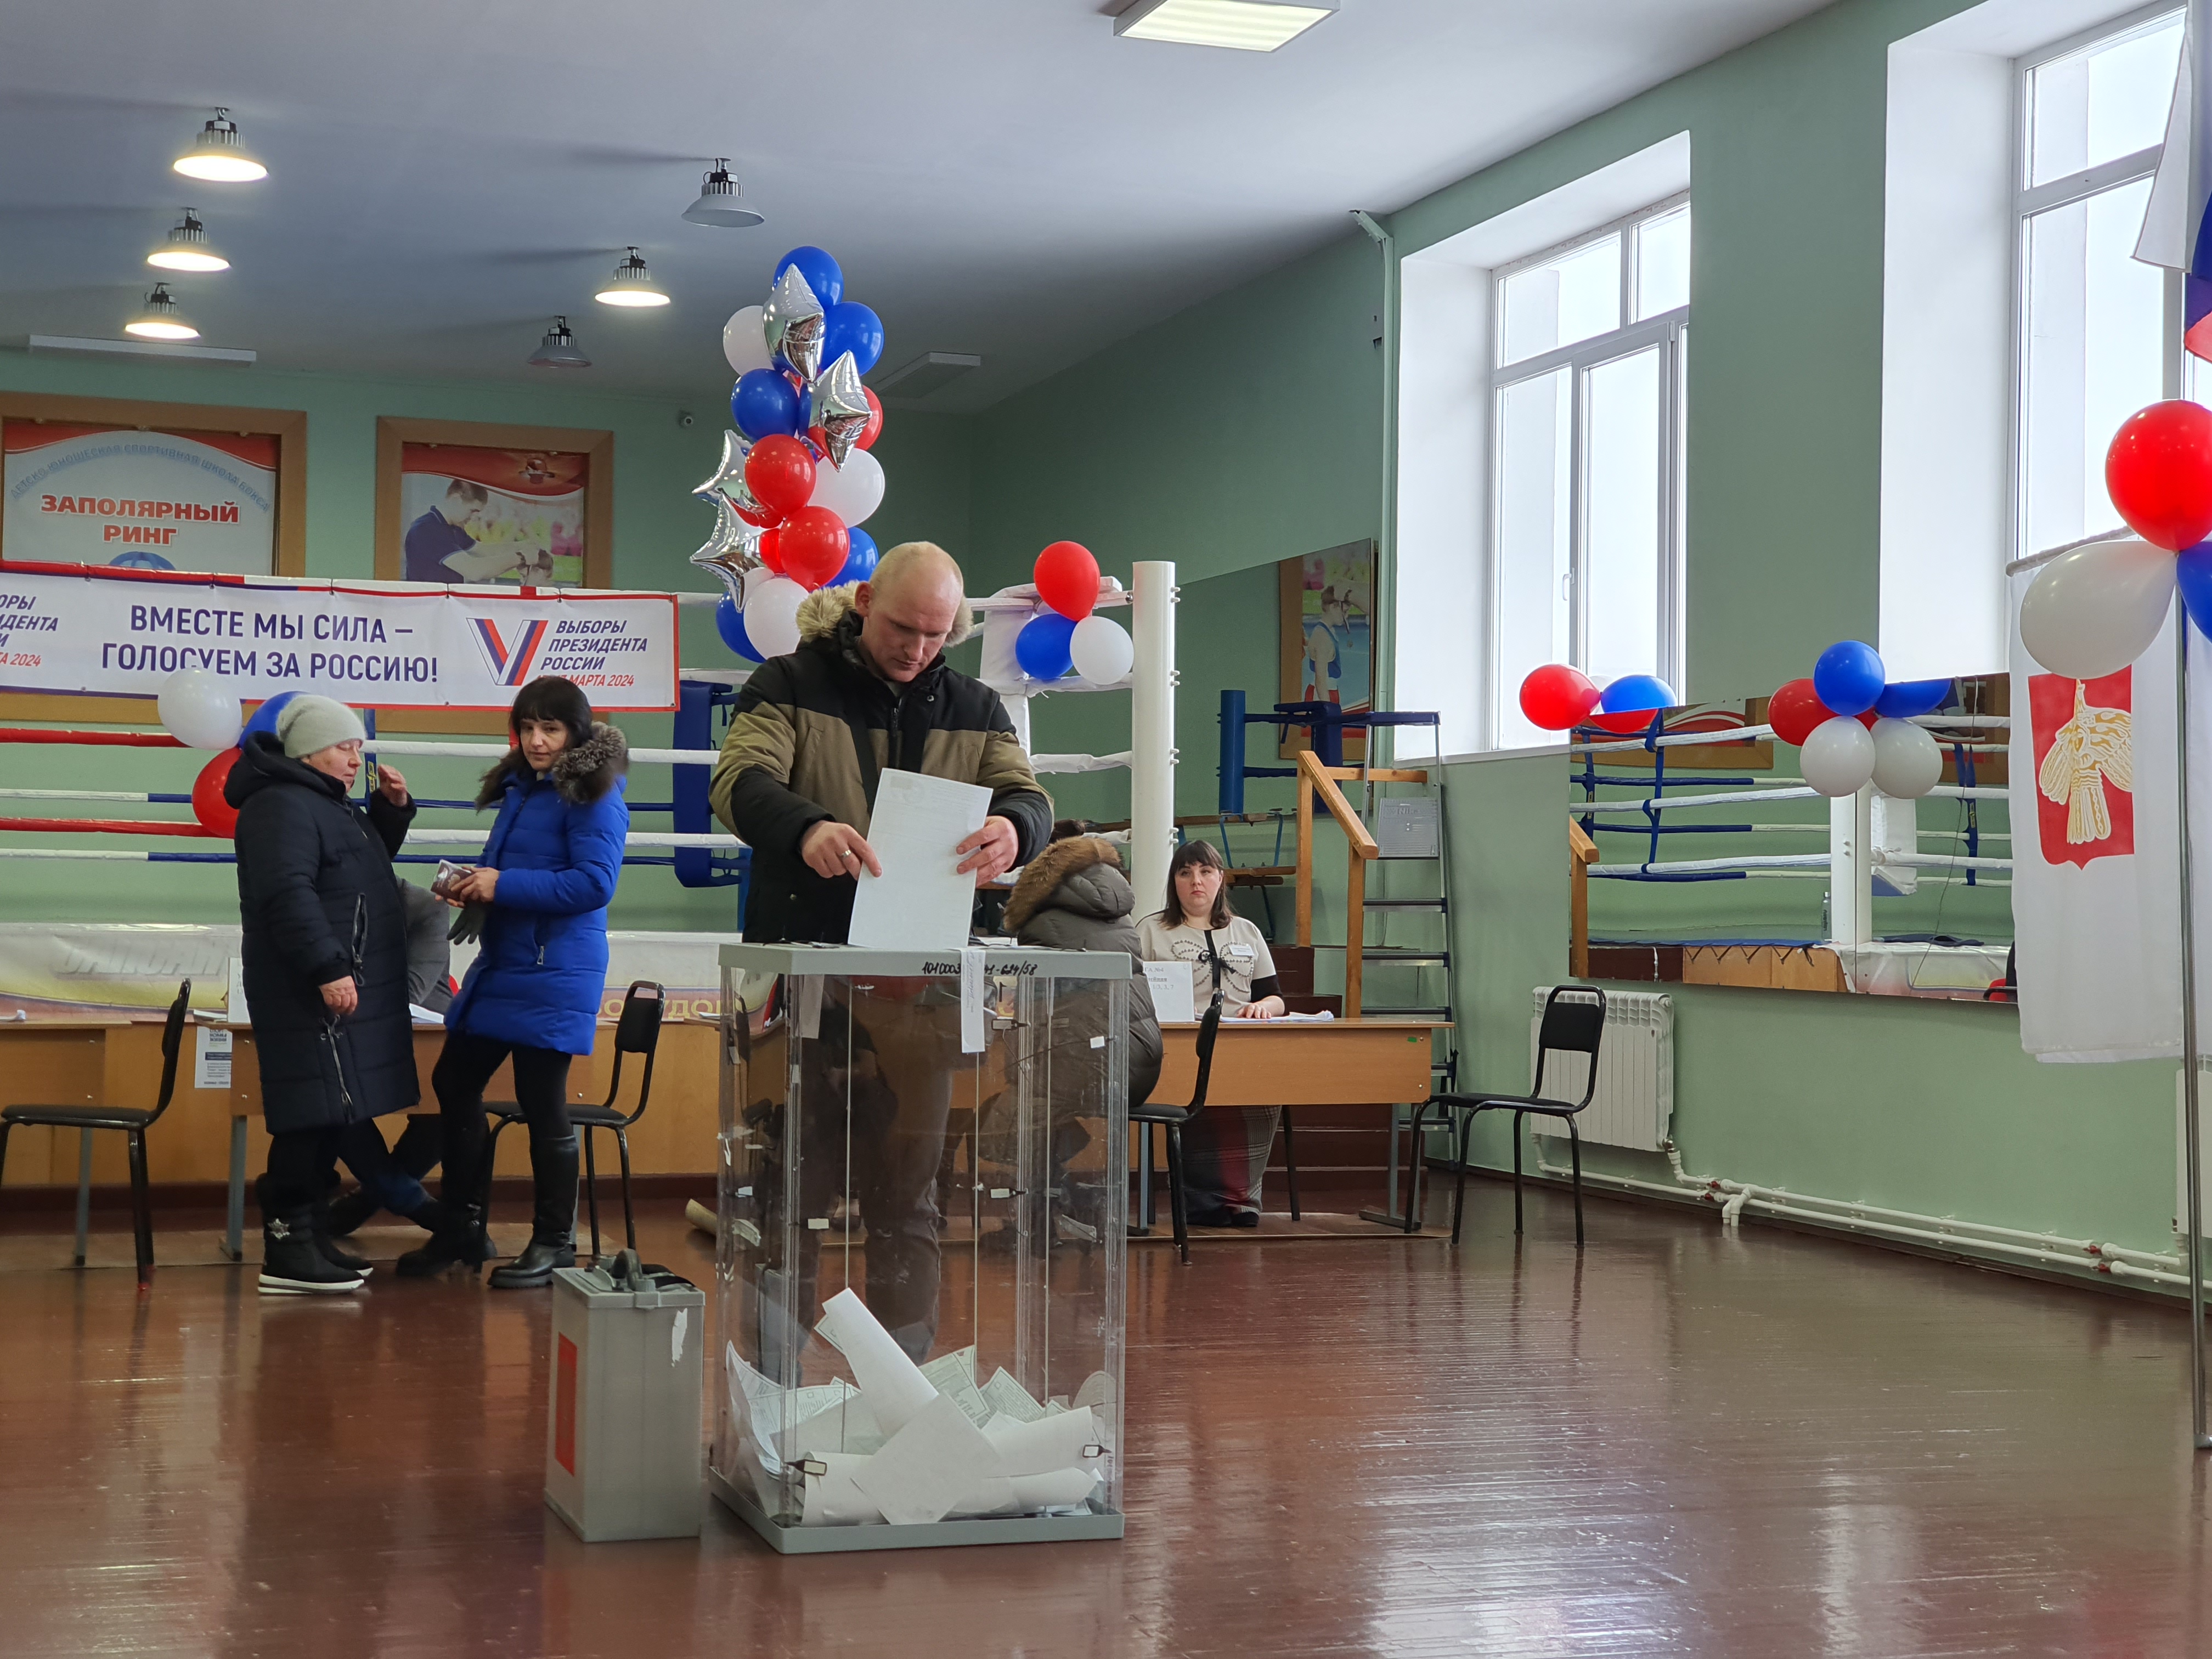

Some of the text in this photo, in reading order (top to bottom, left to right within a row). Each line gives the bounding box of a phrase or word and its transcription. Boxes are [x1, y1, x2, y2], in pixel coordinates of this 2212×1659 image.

[124, 444, 199, 464] СПОРТИВНАЯ
[201, 459, 239, 484] ШКОЛА
[238, 481, 270, 512] БОКСА
[41, 494, 239, 523] ЗАПОЛЯРНЫЙ
[103, 524, 177, 545] РИНГ
[131, 605, 244, 637] ВМЕСТЕ
[254, 613, 303, 640] МЫ
[314, 614, 387, 644] СИЛА
[555, 620, 628, 634] ВЫБОРЫ
[548, 638, 648, 654] ПРЕЗИДЕНТА
[9, 653, 42, 667] 2024
[102, 642, 437, 682] ГОЛОСУЕМ ЗА РОССИЮ!
[540, 656, 606, 670] РОССИИ
[607, 674, 635, 687] 2024
